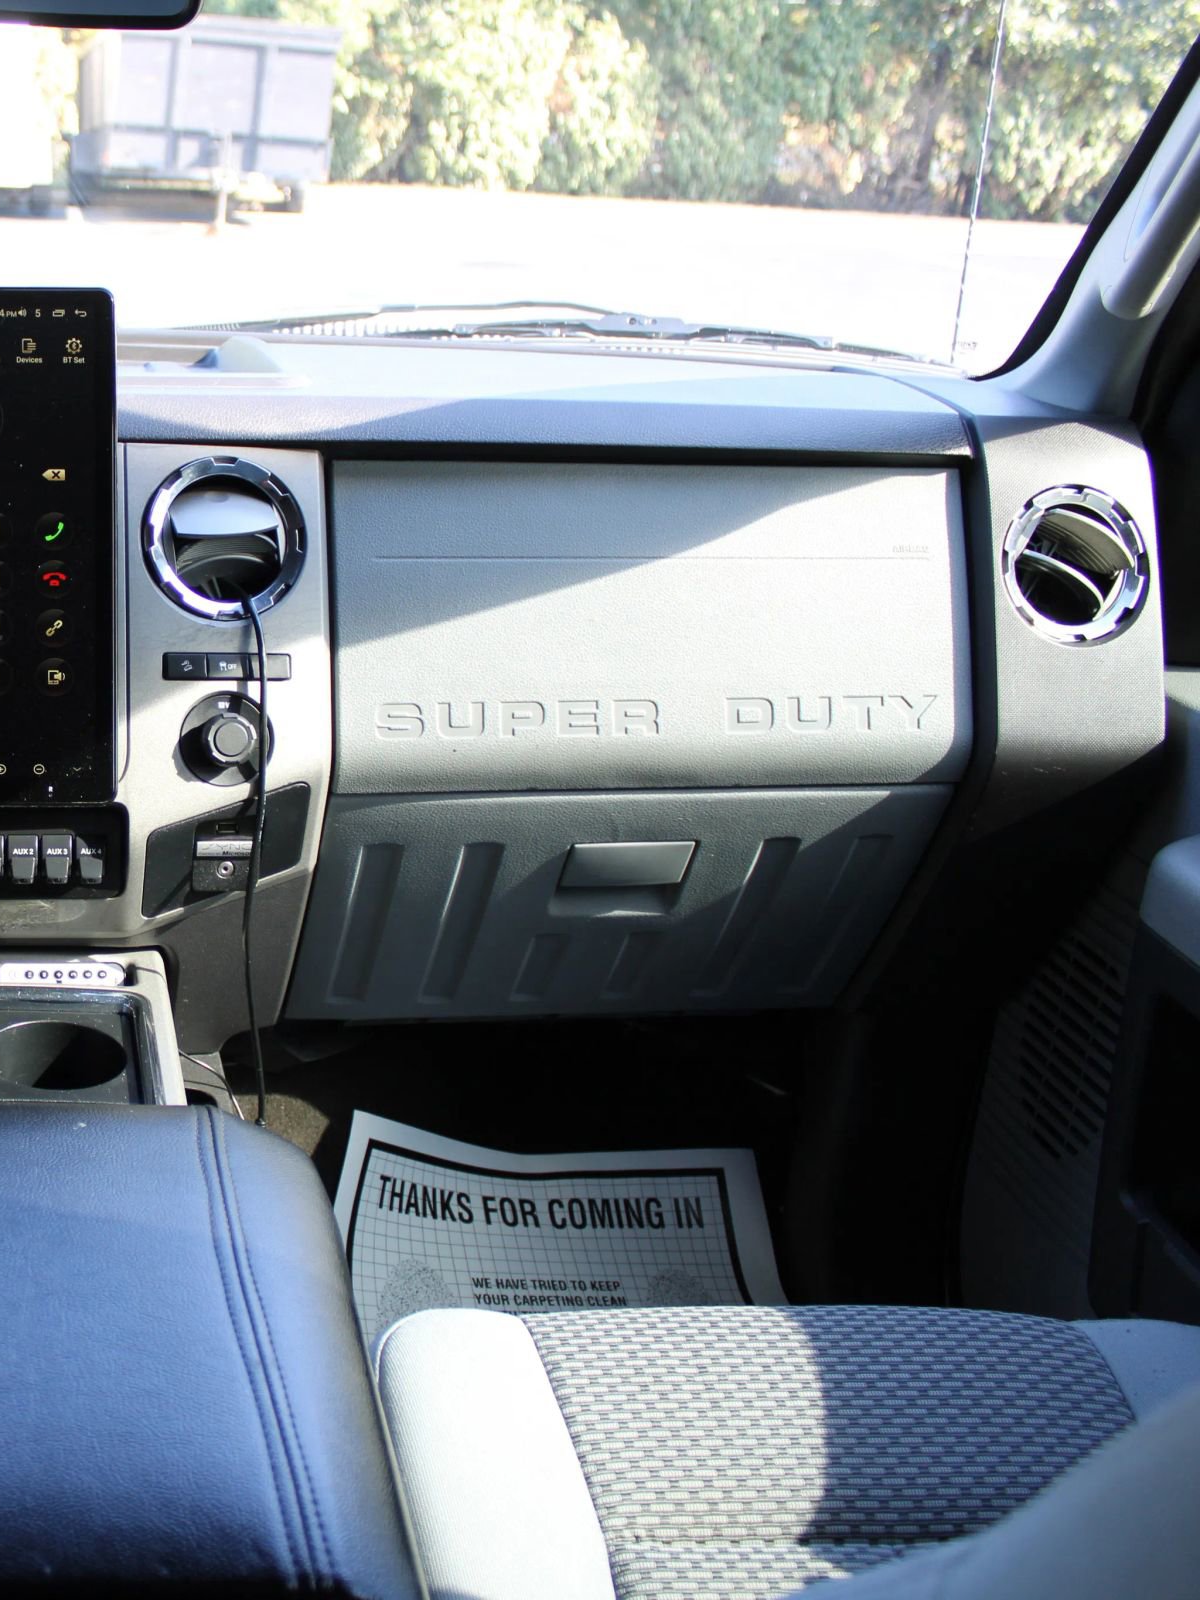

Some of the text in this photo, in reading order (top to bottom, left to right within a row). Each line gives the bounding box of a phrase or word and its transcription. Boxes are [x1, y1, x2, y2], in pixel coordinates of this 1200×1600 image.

[6, 310, 18, 318] PM
[34, 308, 42, 318] 5
[15, 355, 43, 364] Devices
[62, 355, 86, 364] BT Set
[375, 694, 940, 740] SUPER DUTY
[202, 842, 252, 851] SYNC
[378, 1175, 705, 1230] THANKS FOR COMING IN
[472, 1277, 621, 1292] WE HAVE TRIED TO KEEP
[474, 1293, 627, 1307] YOUR CARPETING CLEAN
